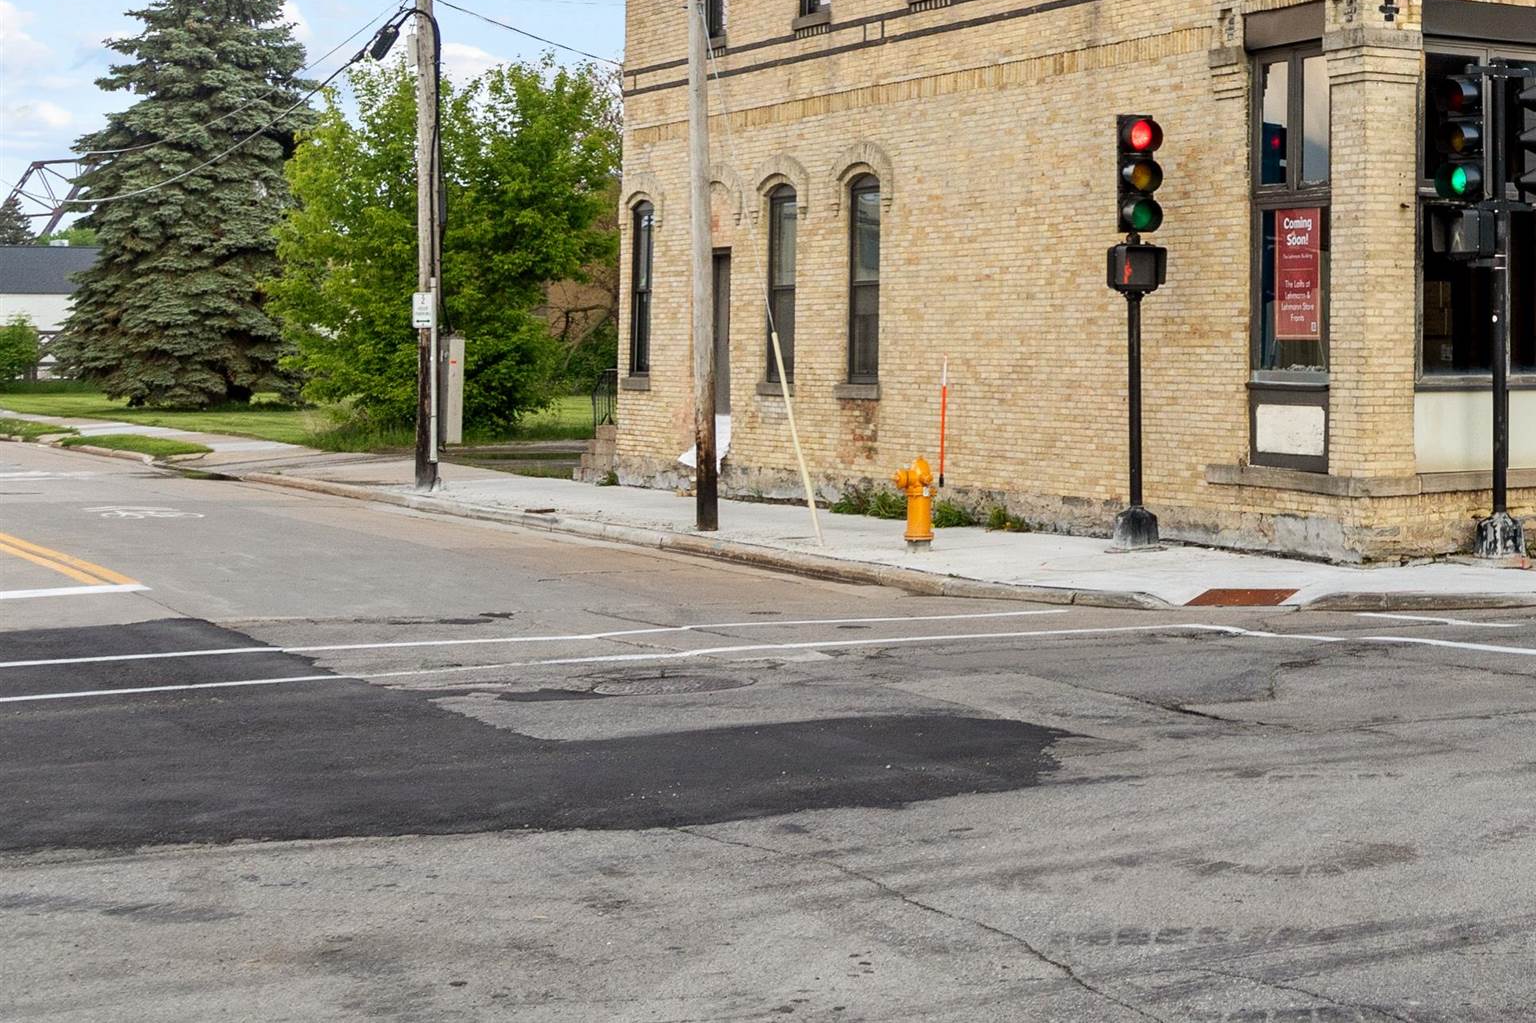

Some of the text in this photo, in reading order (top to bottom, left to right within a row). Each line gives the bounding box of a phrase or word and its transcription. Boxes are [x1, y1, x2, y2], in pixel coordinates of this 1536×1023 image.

[1283, 216, 1312, 231] Coming
[1286, 233, 1309, 246] Soon!
[1285, 279, 1293, 288] The
